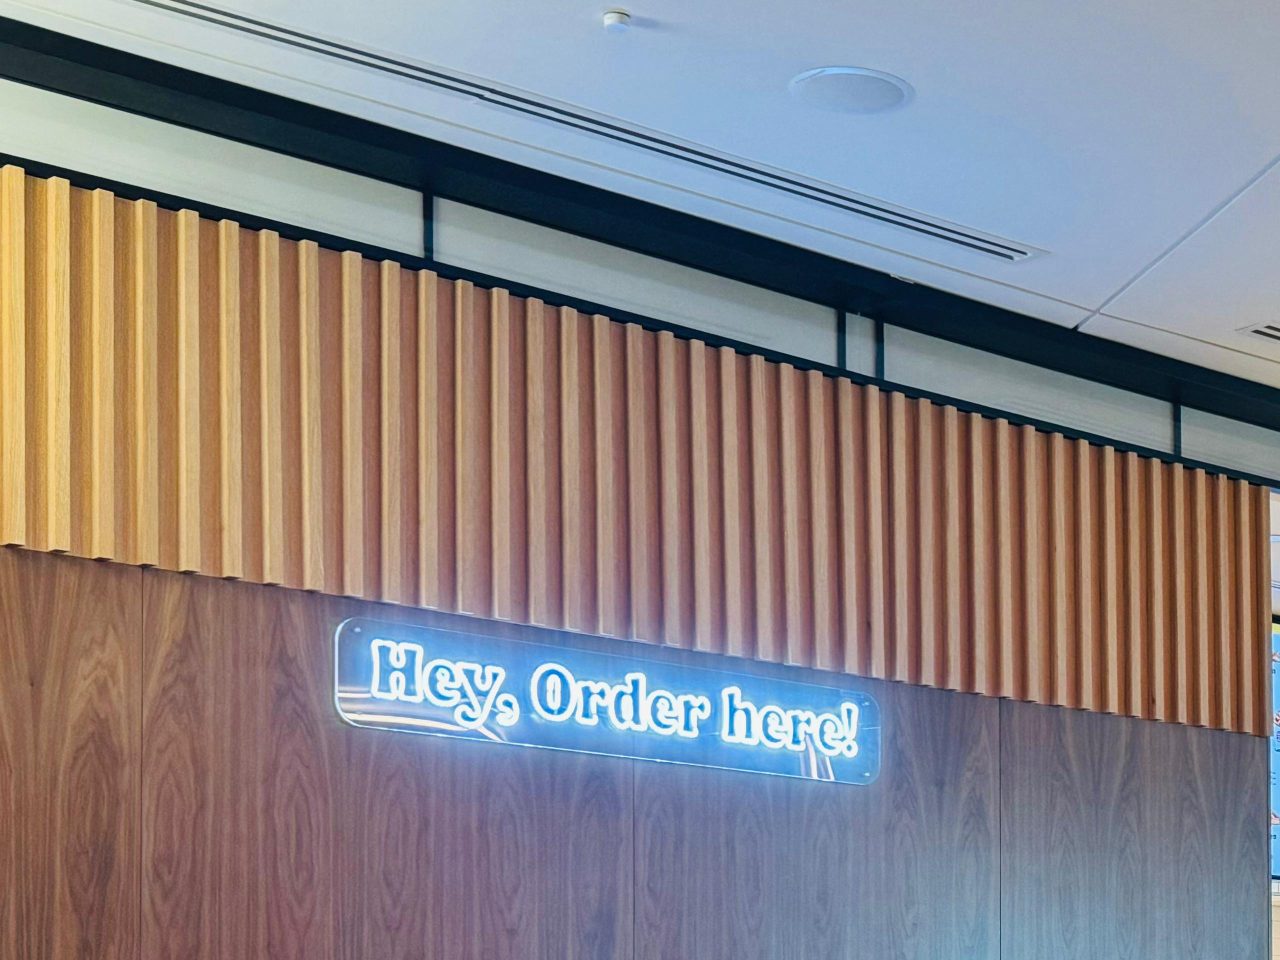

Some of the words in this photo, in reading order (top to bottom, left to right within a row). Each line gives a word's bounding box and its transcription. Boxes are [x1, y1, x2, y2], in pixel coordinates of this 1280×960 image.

[370, 637, 520, 729] Hey,
[530, 661, 711, 738] Order
[721, 686, 860, 758] here!
